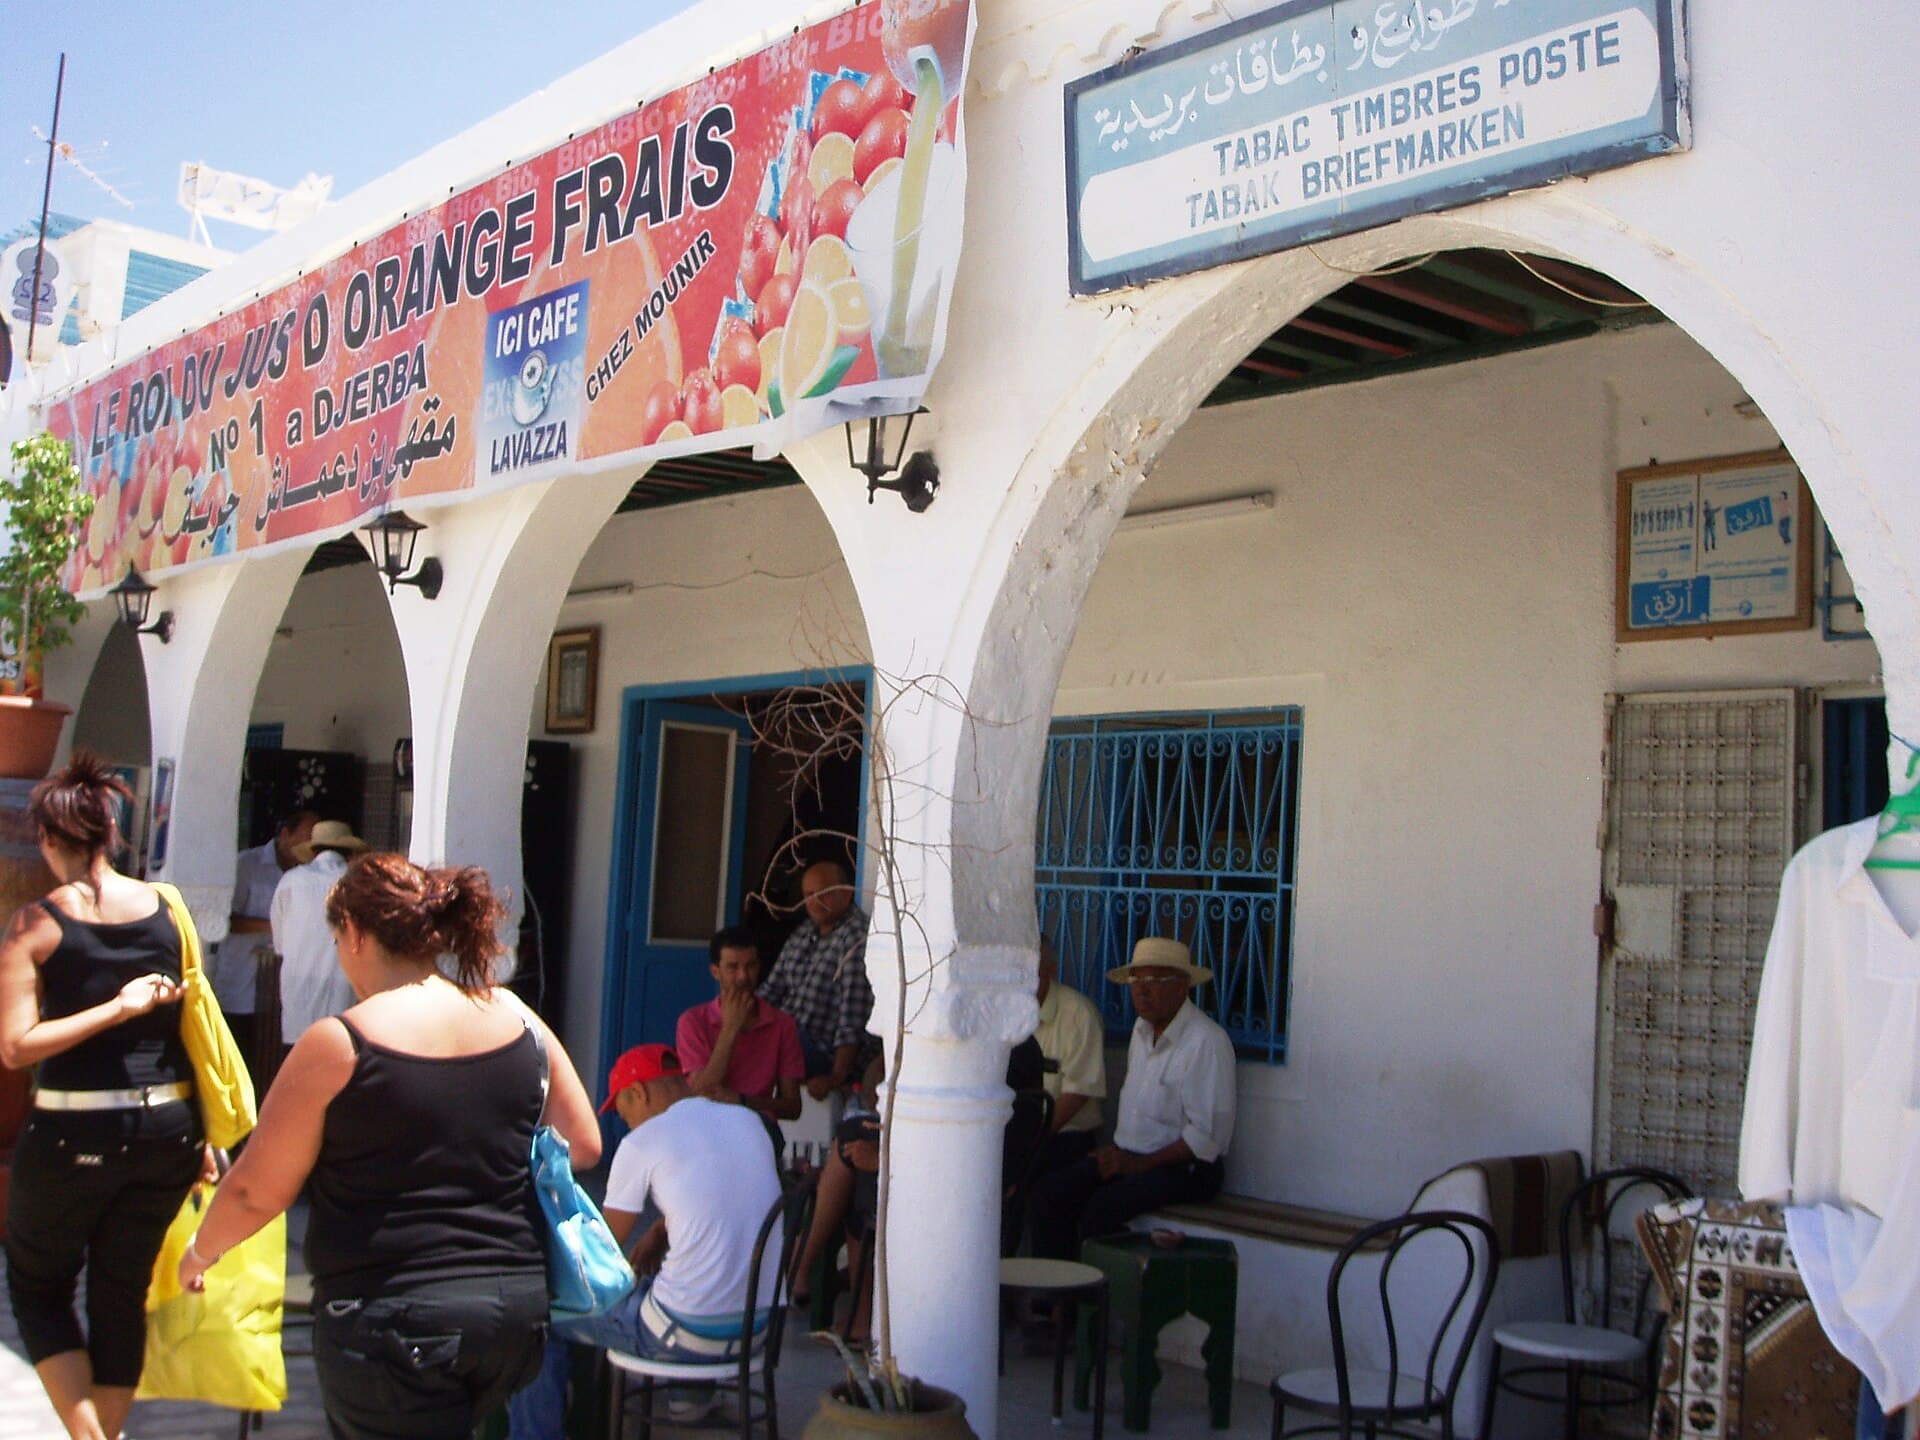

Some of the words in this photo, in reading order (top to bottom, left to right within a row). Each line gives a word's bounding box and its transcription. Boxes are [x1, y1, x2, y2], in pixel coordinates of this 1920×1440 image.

[1094, 86, 1198, 152] بريدية
[1204, 29, 1330, 104] بطاقات
[1213, 115, 1312, 176] TABAC
[1330, 65, 1481, 141] TIMBRES
[1499, 21, 1620, 89] POSTE
[1186, 169, 1281, 228] TABAK
[1301, 101, 1525, 199] BRIEFMARKEN
[92, 390, 122, 458] LE
[124, 366, 173, 442] ROI
[182, 345, 225, 421] DU
[224, 308, 298, 400] JUS
[303, 292, 330, 370] D
[343, 190, 537, 350] ORANGE
[550, 104, 735, 269] FRAIS
[496, 312, 524, 359] ICI
[528, 292, 579, 348] CAFE
[586, 328, 634, 402] CHEZ
[635, 230, 716, 340] MOUNIR
[250, 396, 265, 457] 1
[286, 408, 303, 449] a
[312, 340, 428, 438] DJERBA
[490, 419, 568, 475] LAVAZZA
